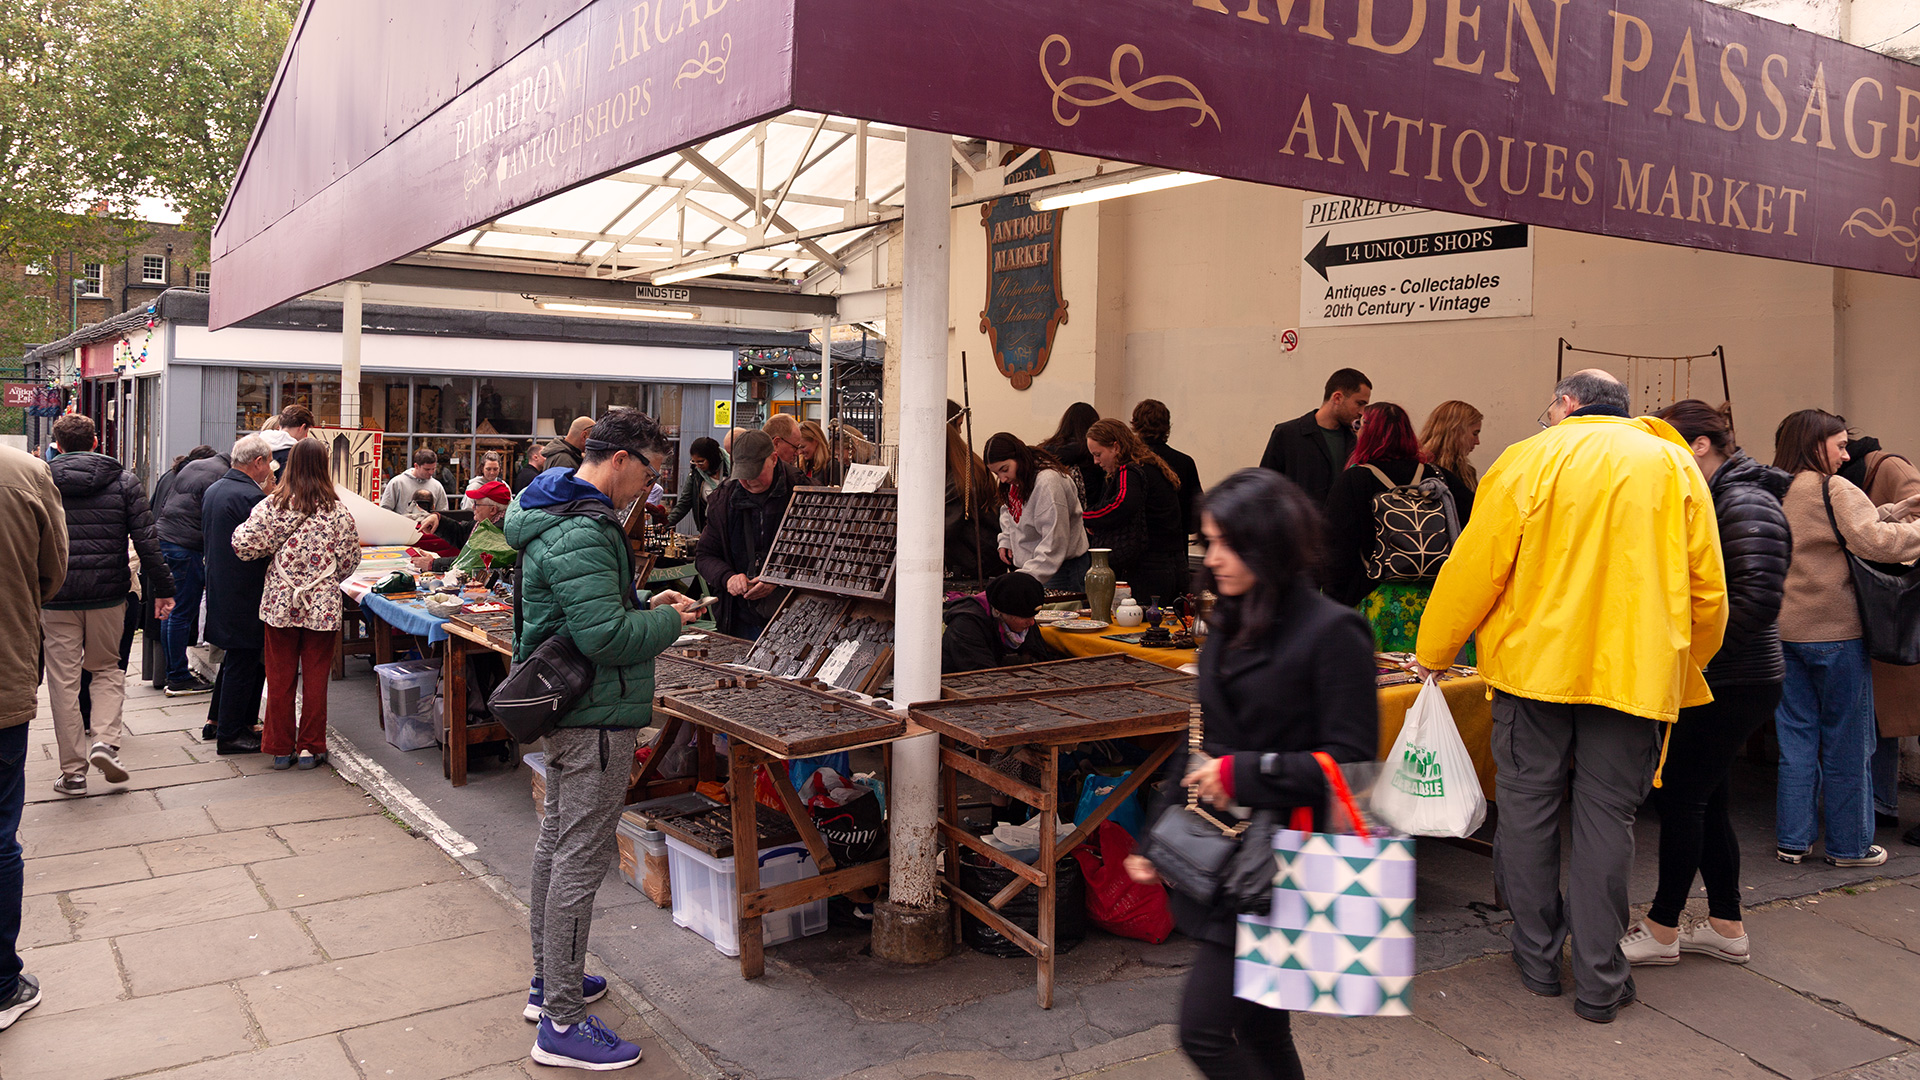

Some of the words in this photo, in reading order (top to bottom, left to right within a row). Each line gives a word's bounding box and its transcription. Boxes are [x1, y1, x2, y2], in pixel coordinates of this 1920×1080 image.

[454, 39, 589, 160] PIERREPONT
[608, 0, 742, 72] ARCA
[1193, 0, 1570, 95] DEN
[1602, 10, 1920, 168] PASSAGE
[1008, 168, 1037, 185] OPEN
[1279, 93, 1595, 207] ANTIQUES
[1612, 158, 1807, 237] MARKET
[1309, 199, 1415, 224] PIERREP
[992, 212, 1052, 243] ANTIQUE
[994, 242, 1051, 272] MARKET
[1345, 246, 1360, 262] 14
[1364, 238, 1430, 259] UNIQUE
[1434, 230, 1493, 251] SHOPS
[637, 286, 688, 299] MINDSTEP
[1324, 283, 1387, 302] Antiques
[1400, 273, 1500, 295] Collectables
[1324, 302, 1353, 318] 20th
[1357, 301, 1415, 317] Century
[1429, 294, 1491, 313] Vintage
[372, 433, 382, 506] METROP
[649, 568, 686, 582] MARK
